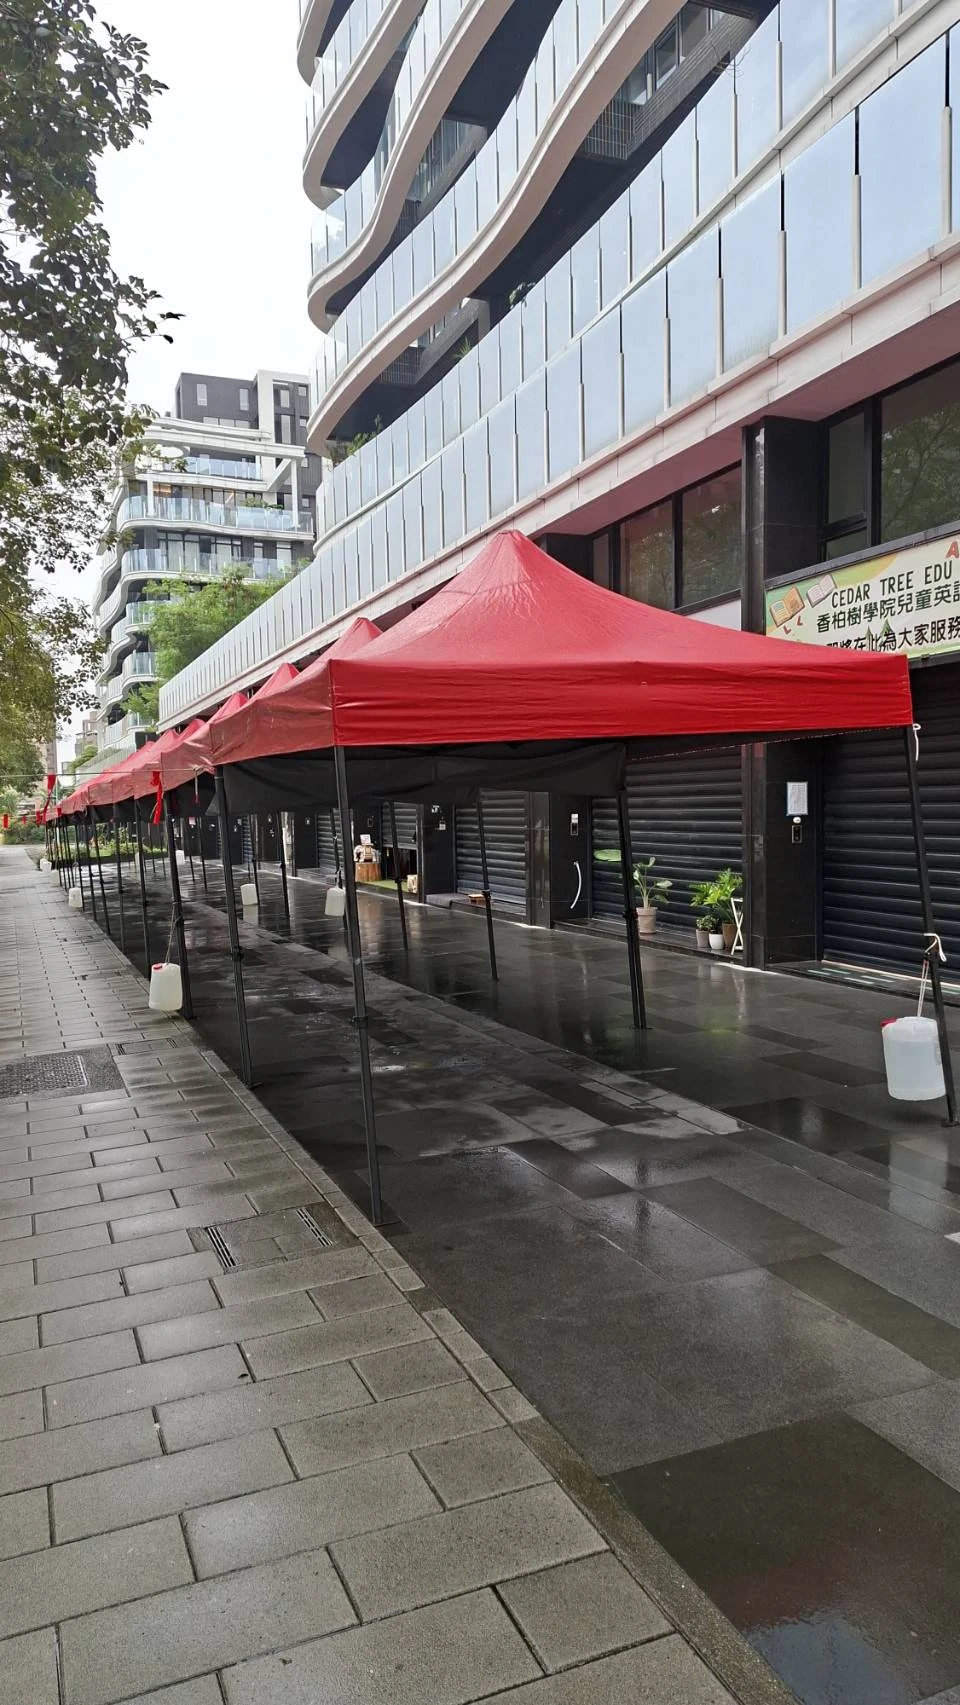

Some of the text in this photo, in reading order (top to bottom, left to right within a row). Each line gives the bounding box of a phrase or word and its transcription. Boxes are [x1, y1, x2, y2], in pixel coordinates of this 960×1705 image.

[831, 560, 952, 609] CEDAR TREE EDU
